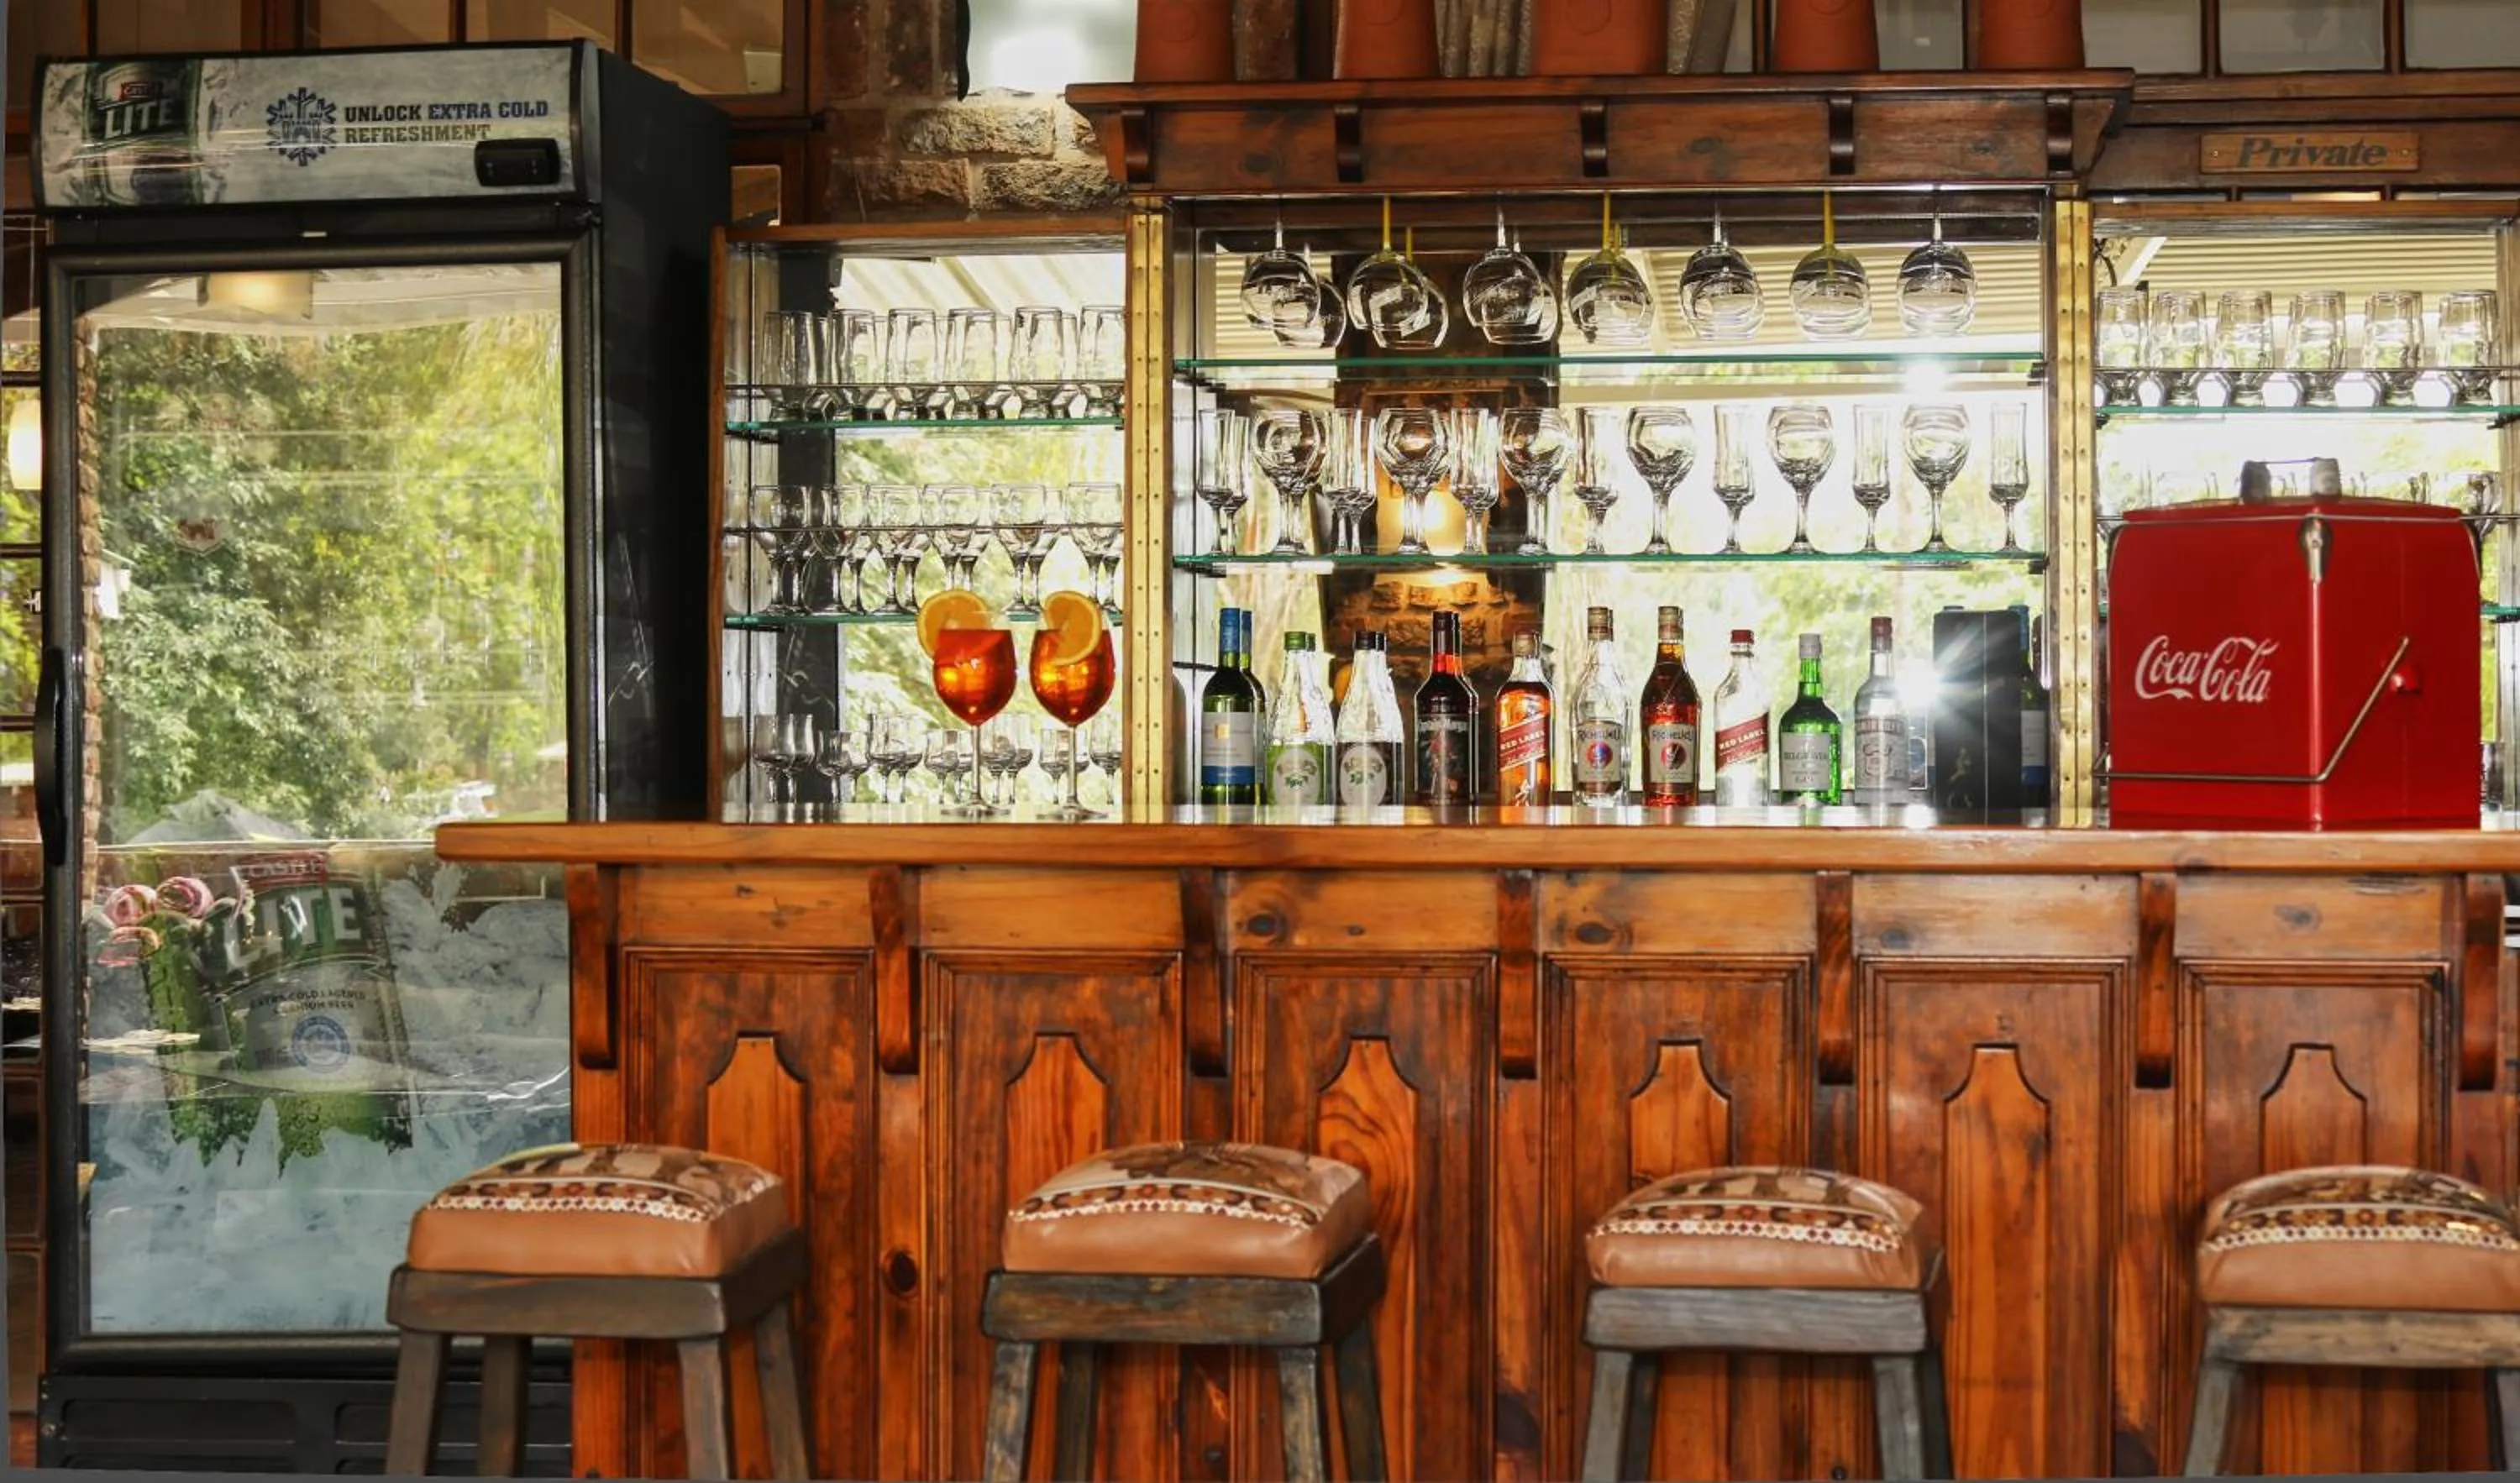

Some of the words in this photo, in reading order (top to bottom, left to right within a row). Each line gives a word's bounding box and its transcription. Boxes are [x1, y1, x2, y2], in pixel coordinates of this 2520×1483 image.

[104, 97, 174, 139] LITE
[344, 105, 423, 123] UNLOCK
[428, 102, 492, 120] EXTRA
[498, 100, 549, 118] COLD
[344, 123, 491, 144] REFRESHMENT
[2237, 136, 2388, 168] Private
[2134, 635, 2279, 704] Coca-Cola
[1719, 738, 1737, 750] RED
[222, 887, 362, 972] LITE
